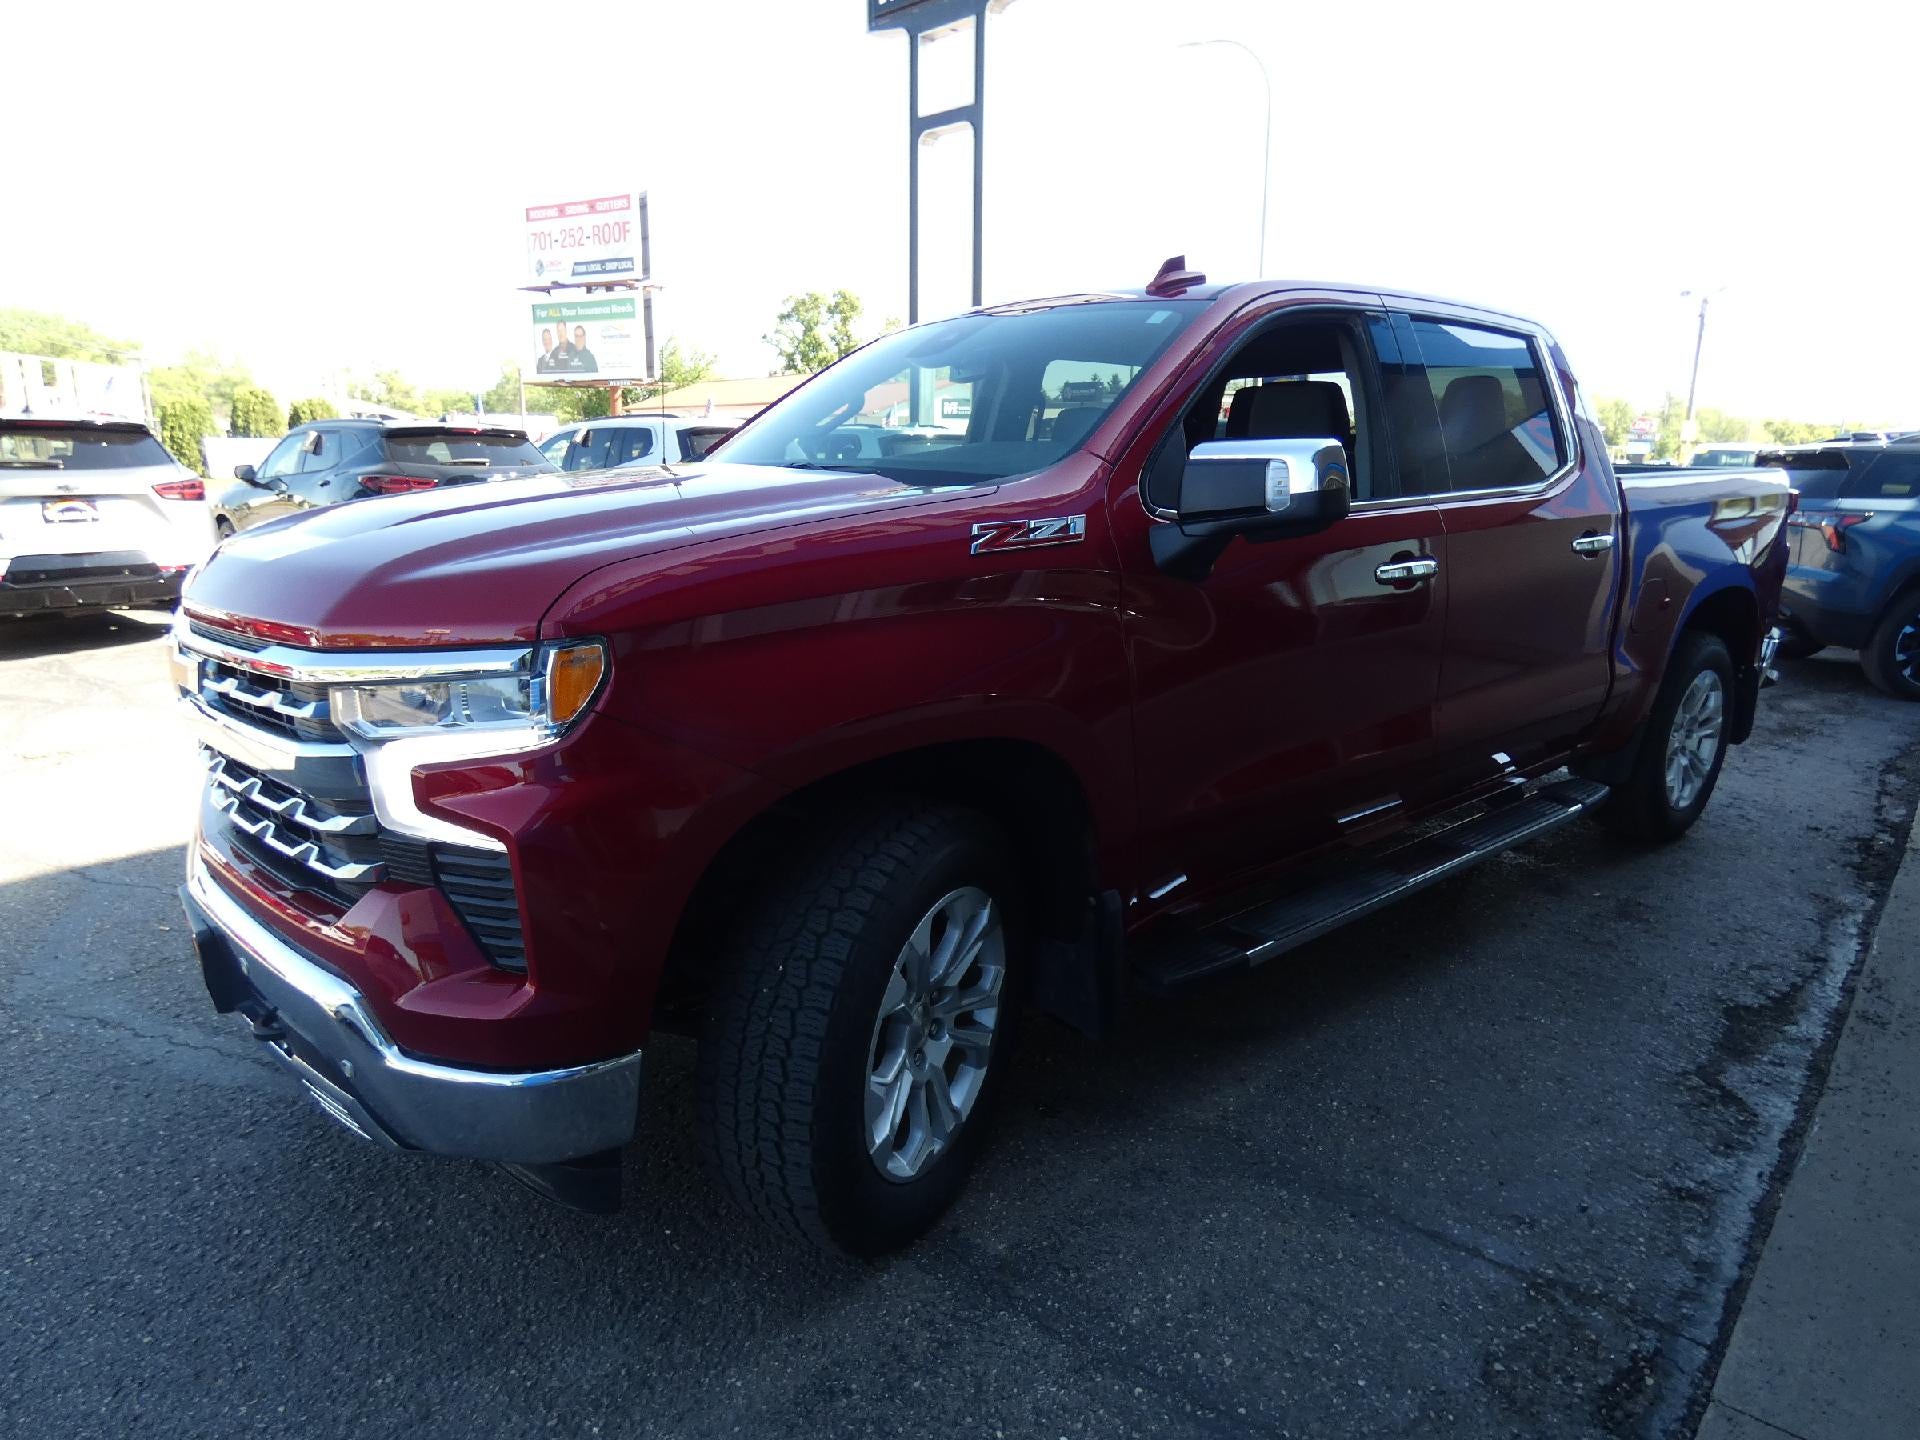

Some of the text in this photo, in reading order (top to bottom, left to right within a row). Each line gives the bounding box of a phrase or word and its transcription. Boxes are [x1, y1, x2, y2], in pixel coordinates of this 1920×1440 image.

[530, 221, 631, 251] 701-252-ROOF
[547, 307, 561, 318] ALL
[970, 513, 1087, 555] Z71
